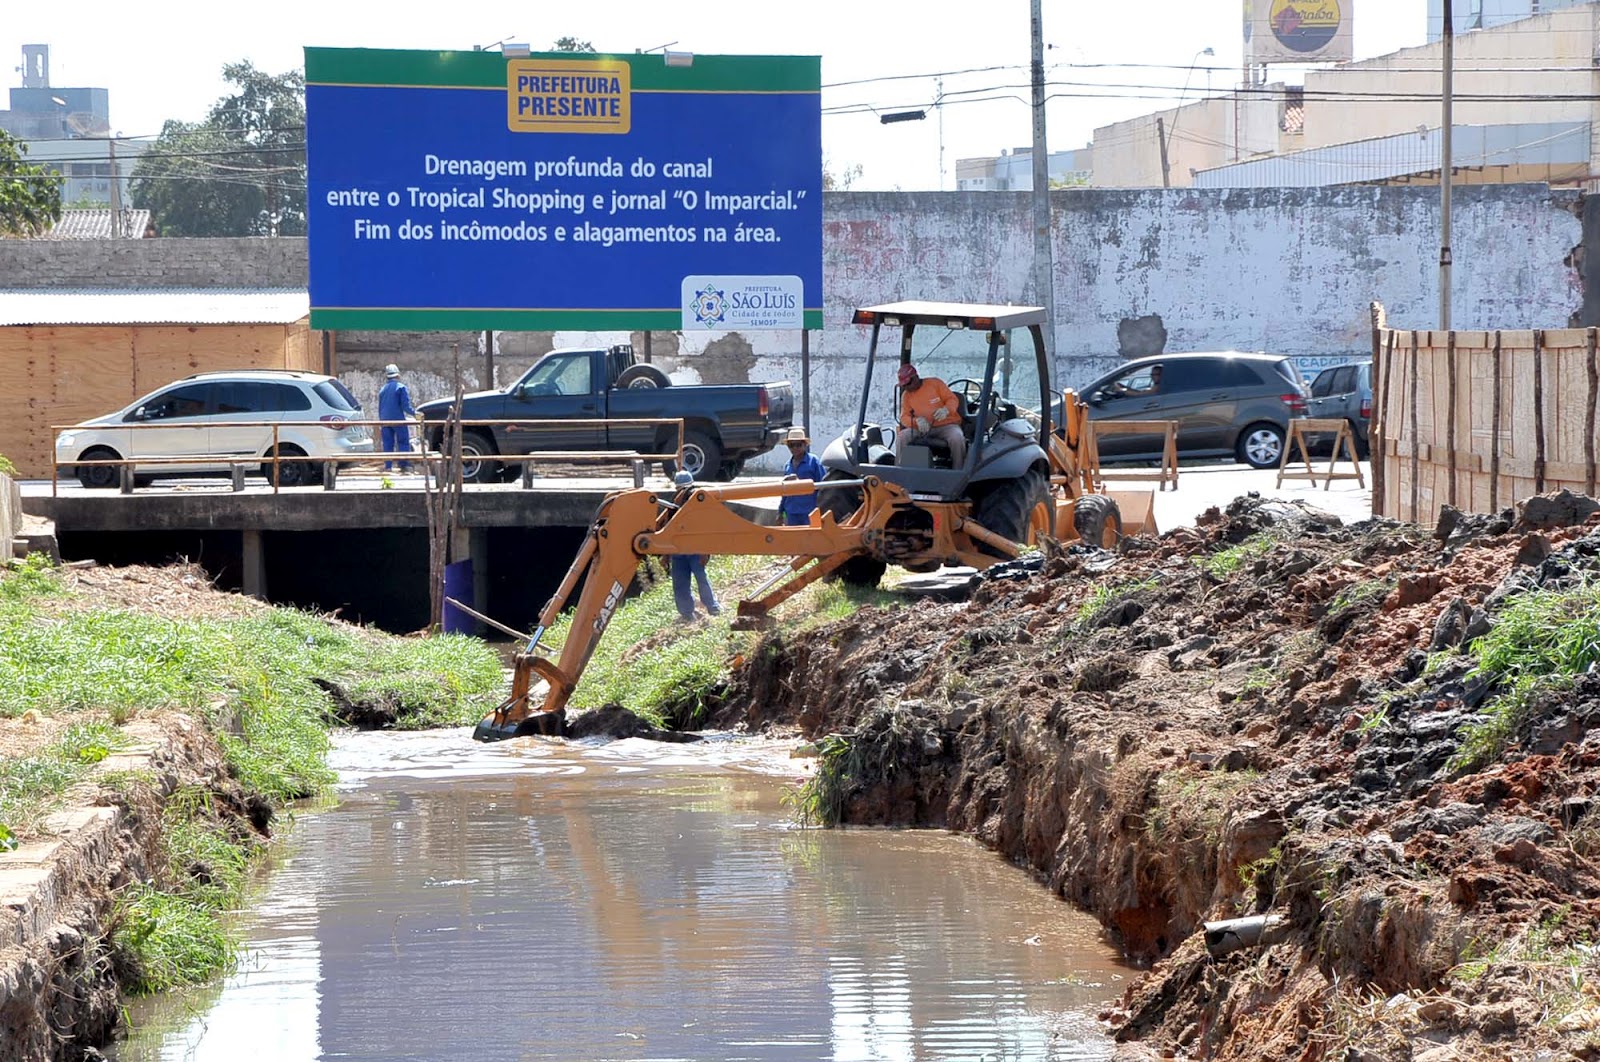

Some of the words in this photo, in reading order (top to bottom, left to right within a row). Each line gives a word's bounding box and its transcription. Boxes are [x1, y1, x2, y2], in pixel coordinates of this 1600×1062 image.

[517, 76, 621, 95] PREFEITURA
[517, 96, 621, 117] PRESENTE
[425, 154, 527, 181] Drenagem
[534, 156, 623, 181] profunda
[630, 157, 656, 178] do
[662, 157, 713, 178] canal
[326, 188, 380, 207] entre
[387, 192, 400, 207] o
[406, 187, 485, 213] Tropical
[492, 188, 585, 215] Shopping
[592, 194, 604, 210] e
[610, 189, 666, 215] jornal
[354, 219, 391, 240] Fim
[398, 219, 434, 240] dos
[441, 219, 548, 241] incômodos
[554, 226, 567, 242] e
[572, 221, 697, 247] alagamentos
[703, 227, 727, 243] na
[733, 222, 781, 243] área.
[732, 292, 762, 309] SÃO
[732, 310, 760, 318] Cidade
[762, 310, 771, 318] de
[773, 310, 796, 318] todos
[750, 319, 778, 327] SEMOSP
[593, 580, 624, 632] CASE
